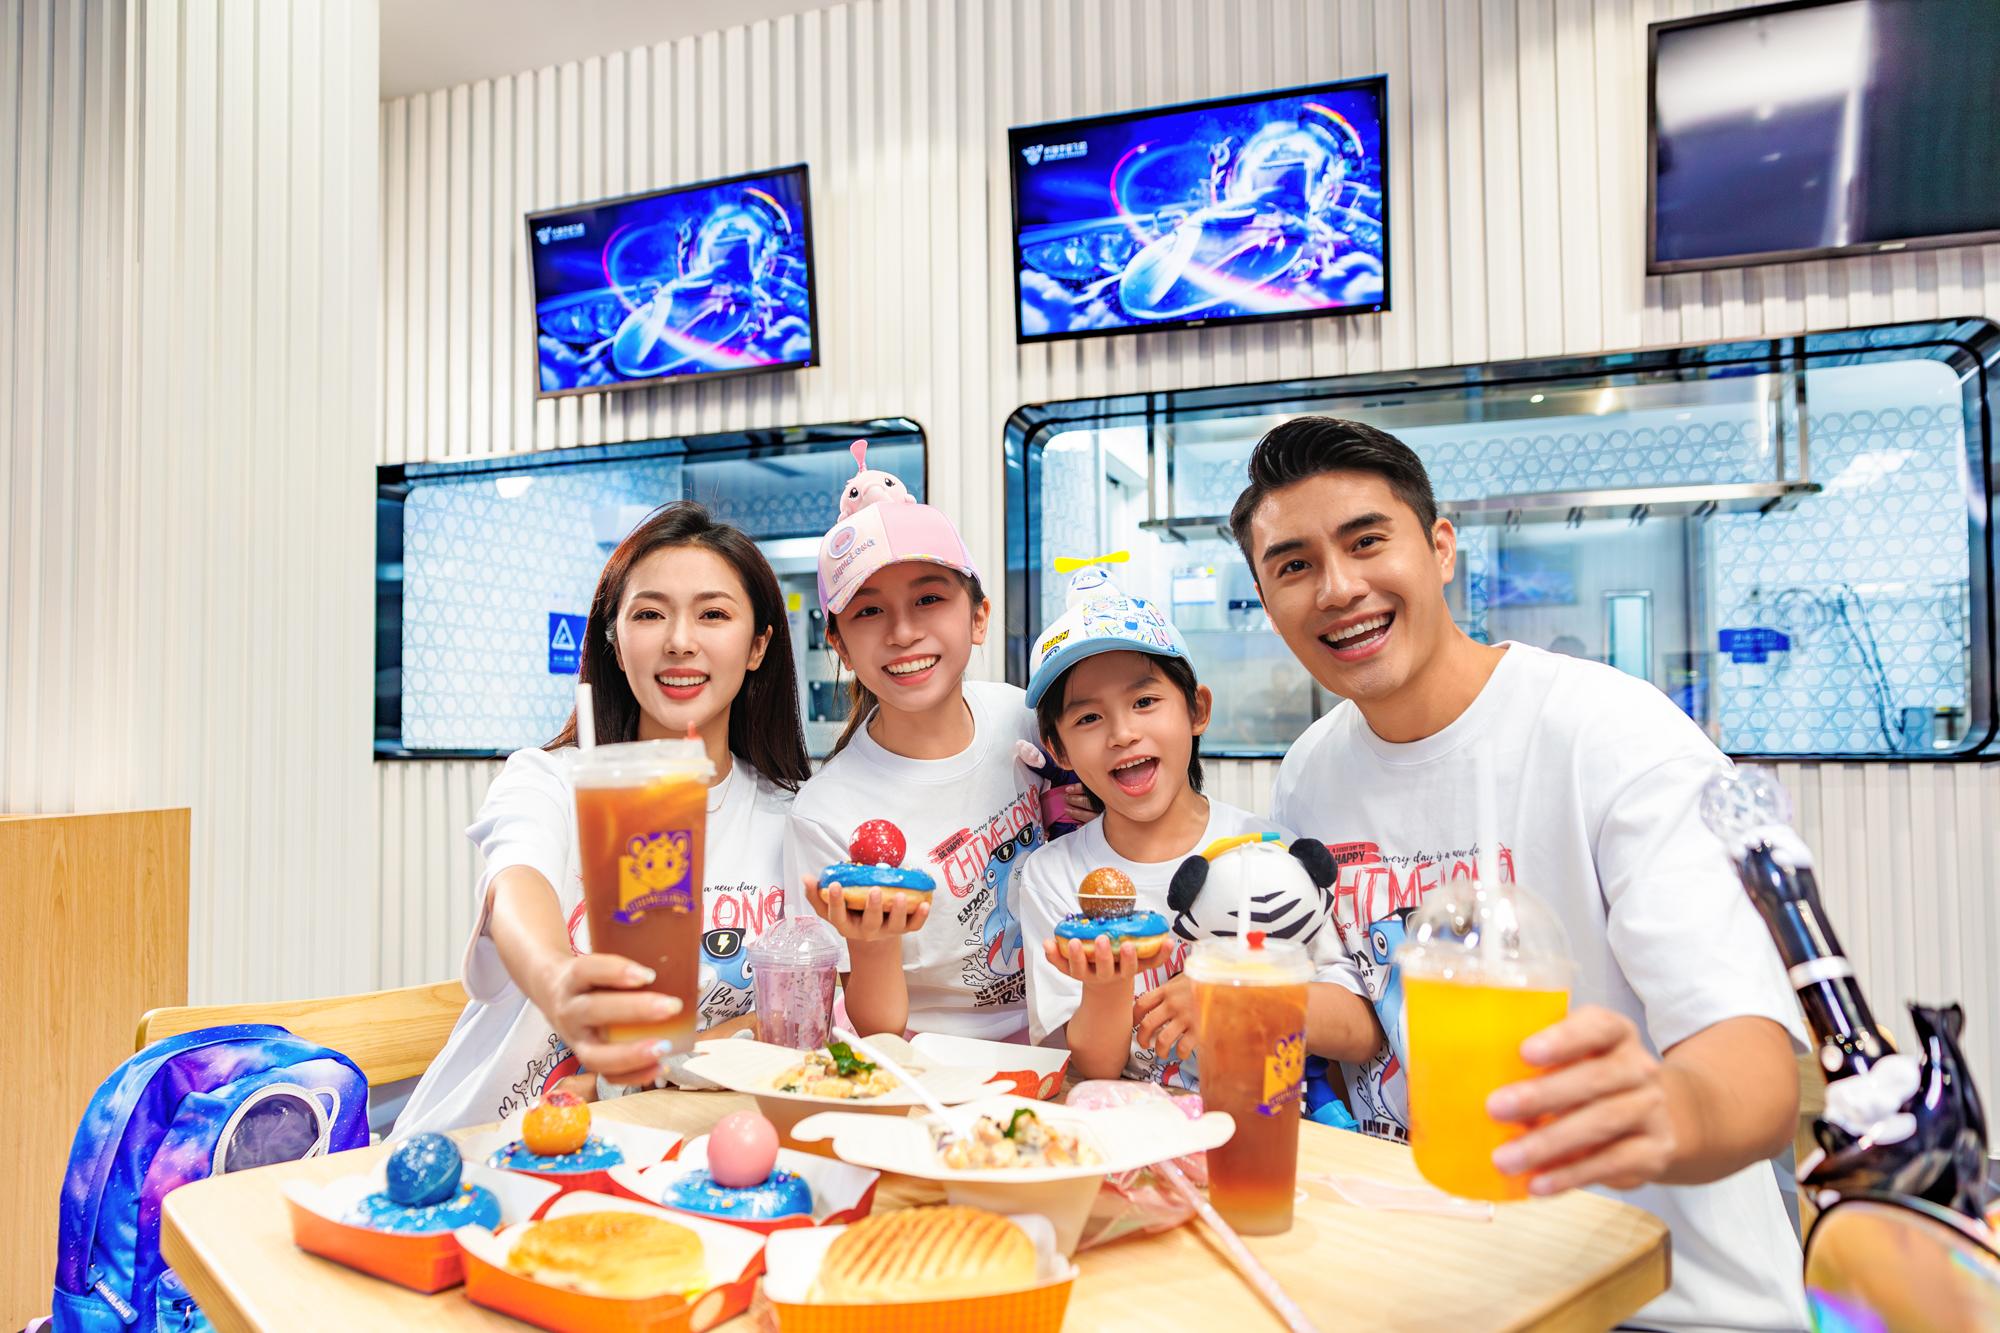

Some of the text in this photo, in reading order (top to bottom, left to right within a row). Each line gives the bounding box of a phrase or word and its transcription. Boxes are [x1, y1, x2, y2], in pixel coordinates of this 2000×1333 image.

[1041, 629, 1070, 654] BEACH
[946, 836, 965, 854] HAPPY
[1382, 851, 1411, 869] every
[1413, 849, 1435, 864] day
[1468, 842, 1480, 856] da
[736, 881, 759, 896] day
[708, 986, 753, 1008] Be Ju
